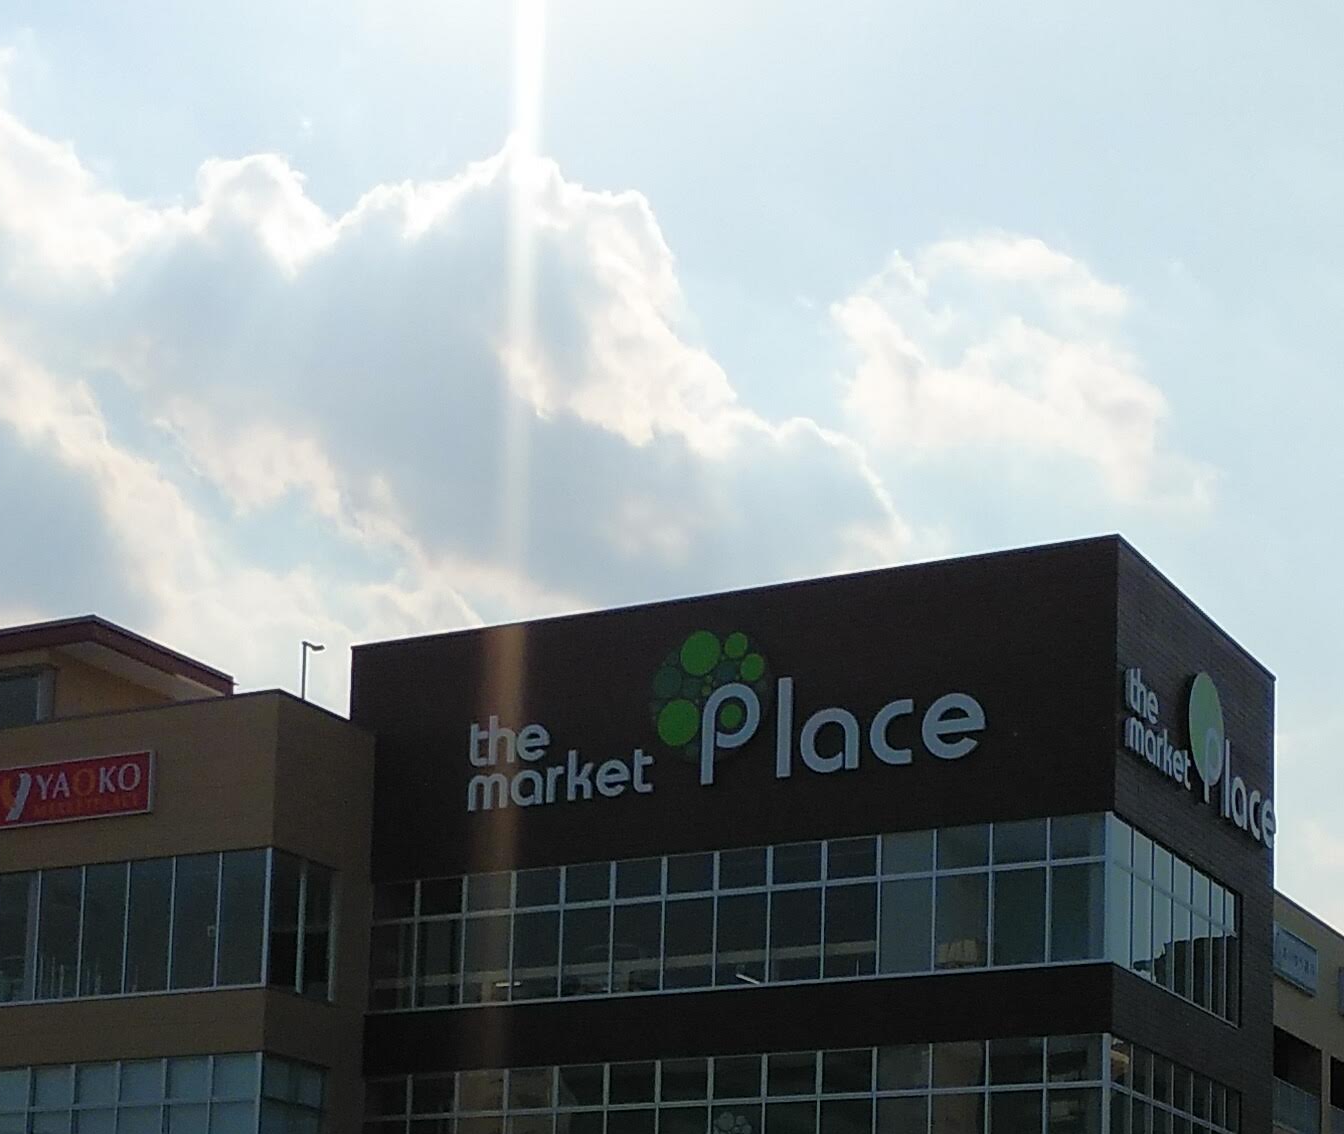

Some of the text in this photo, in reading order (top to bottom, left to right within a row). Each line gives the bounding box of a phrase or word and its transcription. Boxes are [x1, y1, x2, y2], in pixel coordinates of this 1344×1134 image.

[1125, 667, 1160, 725] the
[469, 715, 551, 768] the
[1123, 716, 1192, 791] market
[35, 762, 142, 801] YAOKO
[467, 748, 655, 812] market
